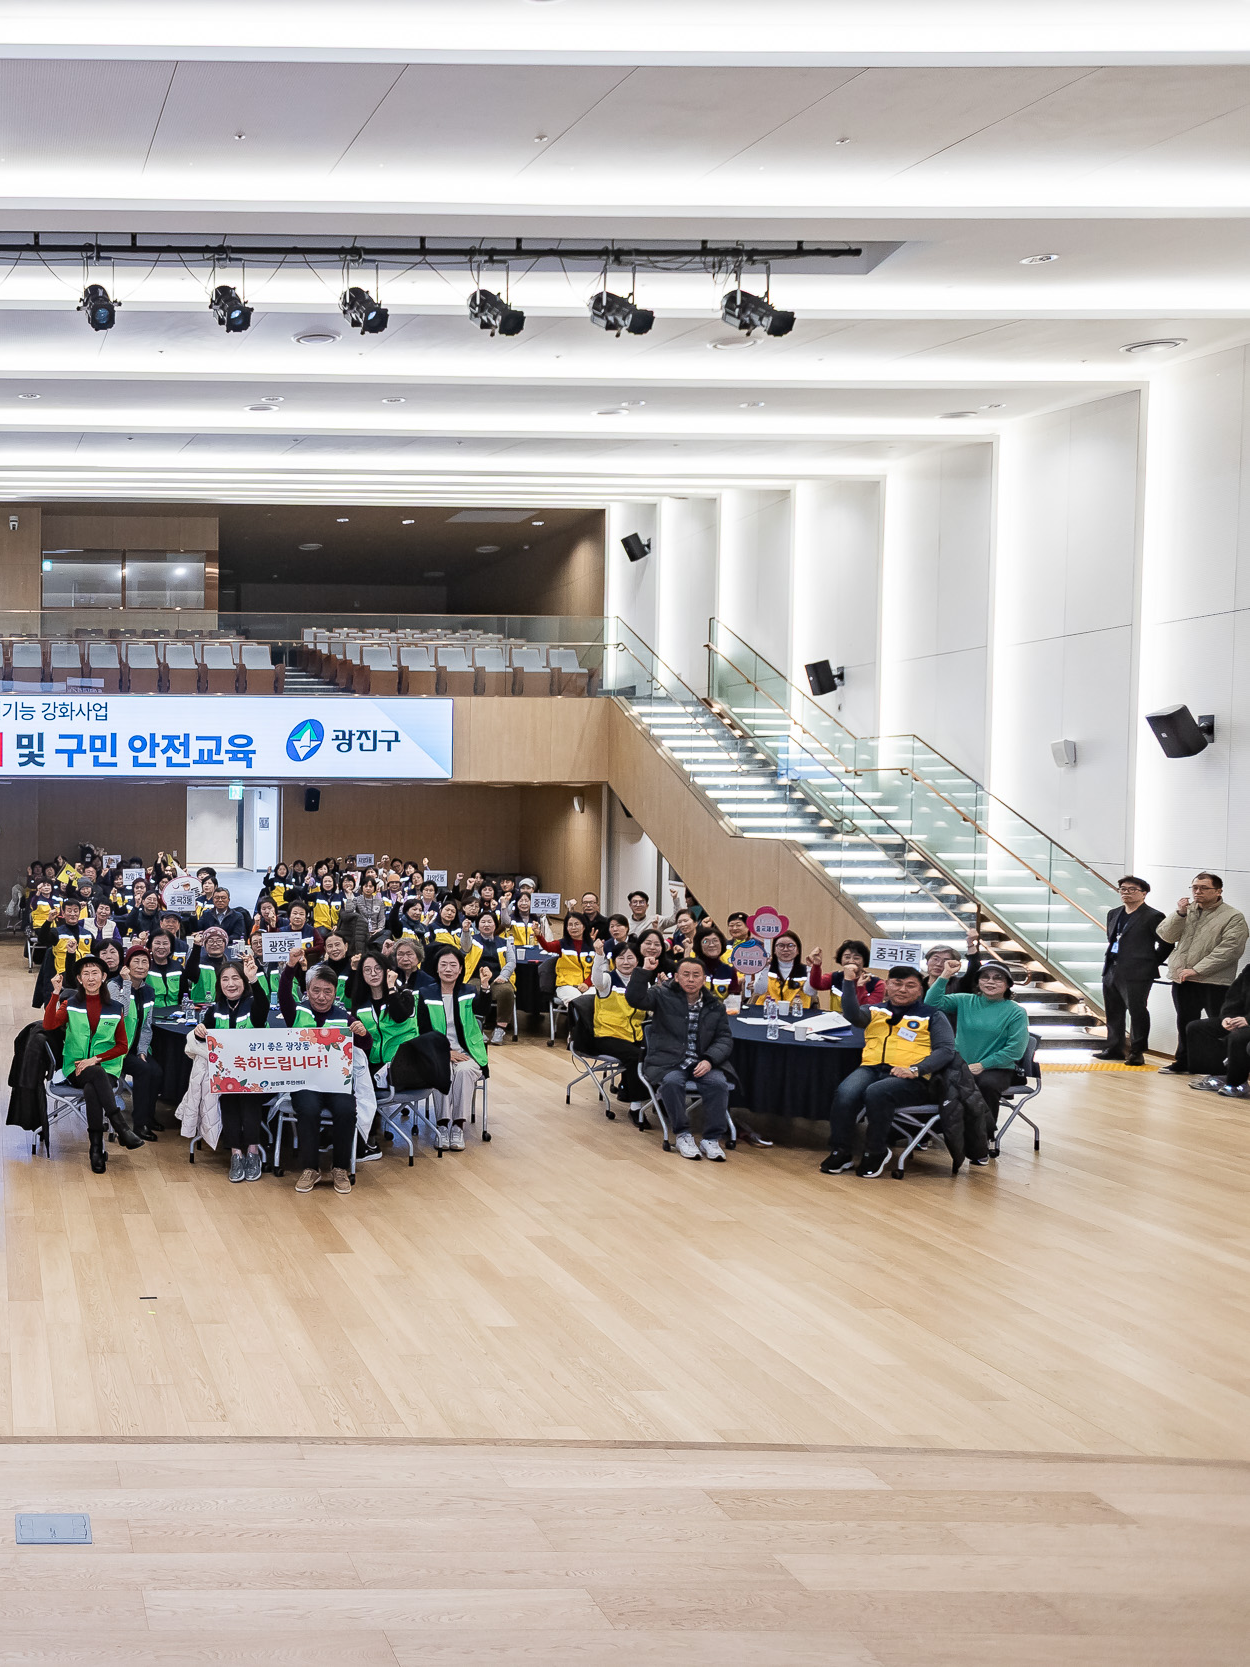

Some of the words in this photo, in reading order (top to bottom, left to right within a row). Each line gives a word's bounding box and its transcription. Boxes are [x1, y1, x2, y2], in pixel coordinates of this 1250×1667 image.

[41, 701, 108, 721] 강화사업
[331, 729, 401, 753] 광진구
[16, 732, 45, 767] 및
[54, 732, 117, 768] 구민
[128, 732, 257, 769] 안전교육
[170, 895, 193, 905] 중곡3동
[533, 898, 557, 909] 중곡2동
[269, 940, 296, 953] 광장동
[876, 947, 916, 963] 중곡1동
[248, 1042, 265, 1051] 살기
[267, 1042, 283, 1051] 좋은
[285, 1041, 311, 1051] 광장동
[233, 1055, 329, 1071] 축하드립니다!
